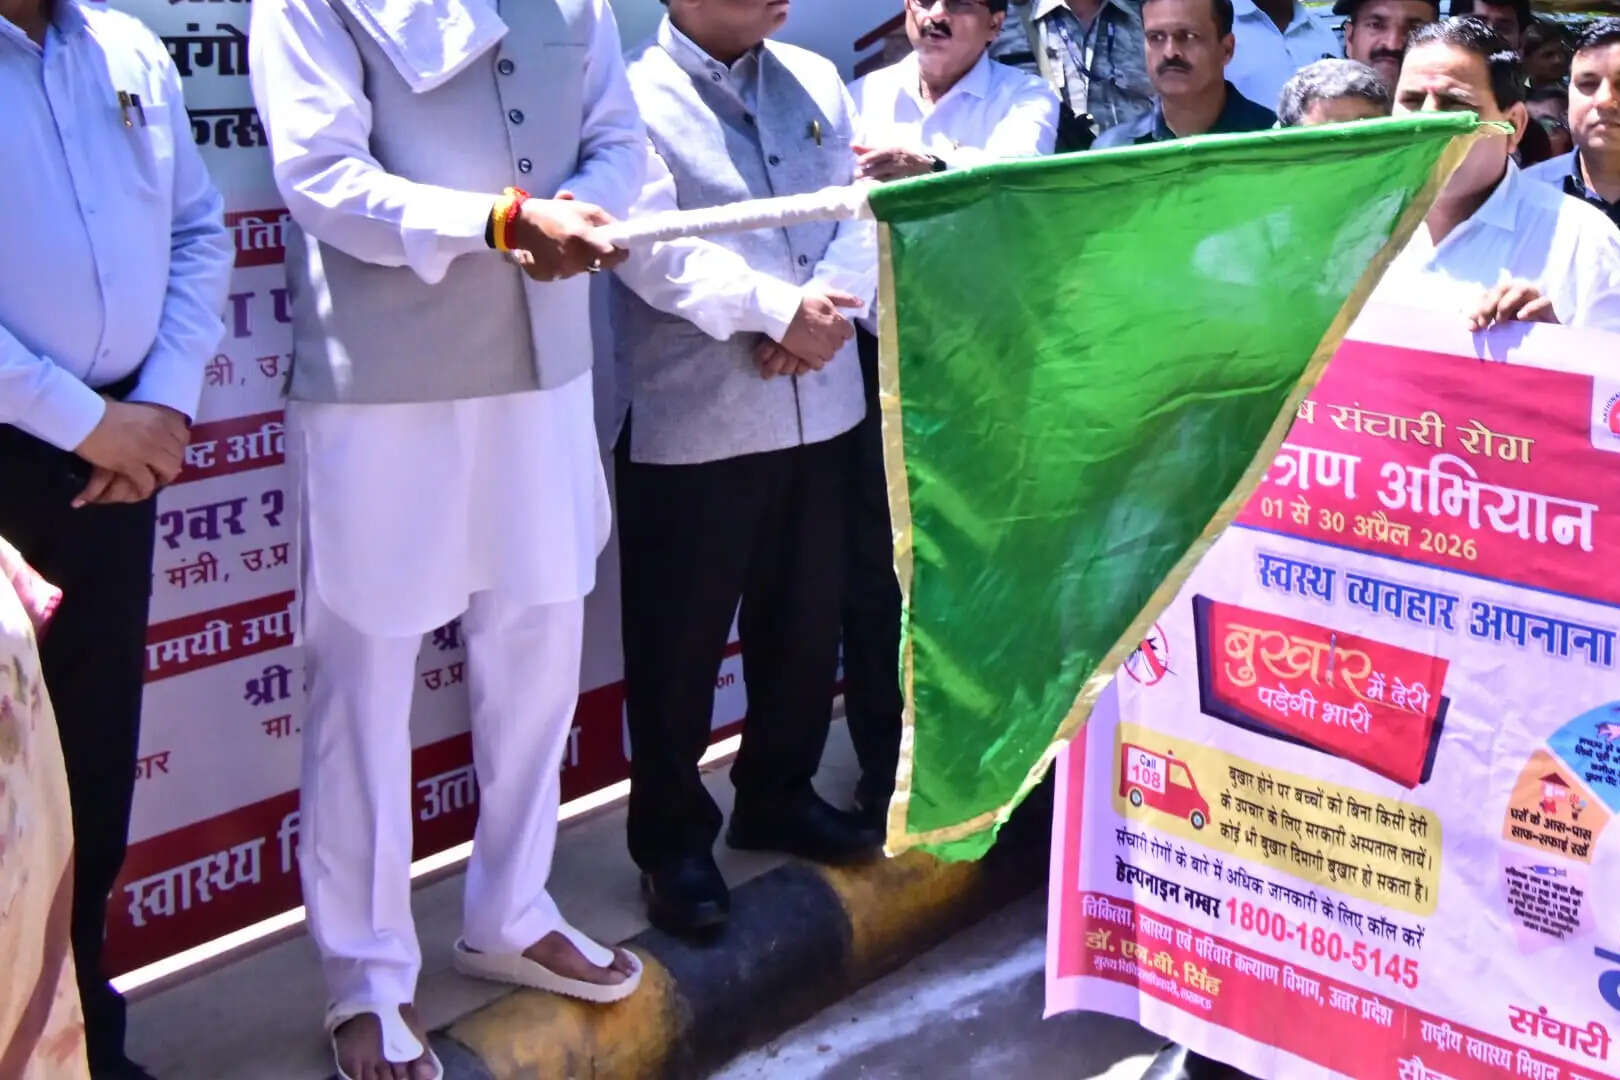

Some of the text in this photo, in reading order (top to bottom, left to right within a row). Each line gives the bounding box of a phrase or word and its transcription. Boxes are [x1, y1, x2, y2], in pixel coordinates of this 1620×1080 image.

[1327, 402, 1446, 448] संचारी
[1456, 420, 1536, 464] रोग
[1261, 493, 1478, 561] 01 से 30 अप्रैल 2026
[1377, 453, 1599, 553] अभियान
[1258, 553, 1336, 602] स्वस्थ
[1346, 573, 1459, 631] व्यवहार
[1470, 600, 1617, 668] अपनाना
[244, 664, 293, 707] श्री
[1321, 701, 1373, 733] भारी
[1368, 669, 1387, 701] में
[1391, 676, 1432, 713] देरी
[1131, 764, 1162, 791] 108
[1139, 753, 1157, 770] Call
[1229, 766, 1254, 791] बुखार
[1256, 773, 1273, 796] होने
[1277, 782, 1291, 800] पर
[1327, 792, 1344, 815] को
[1347, 796, 1372, 818] बिना
[1376, 803, 1405, 832] किसी
[1408, 812, 1428, 839] देरी
[1234, 797, 1265, 819] उपचार
[1281, 809, 1303, 840] लिए
[1305, 820, 1346, 847] सरकारी
[1350, 834, 1398, 861] अस्पताल
[123, 835, 267, 928] स्वास्थ्य
[1115, 825, 1148, 855] संचारी
[1175, 846, 1188, 868] के
[1213, 858, 1225, 880] में
[1226, 867, 1264, 894] अधिक
[1268, 881, 1318, 913] जानकारी
[1321, 896, 1336, 919] के
[1338, 902, 1364, 936] लिए
[1367, 917, 1398, 943] कॉल
[1402, 925, 1426, 950] करें
[1219, 819, 1241, 844] कोई
[1245, 828, 1258, 848] भी
[1261, 835, 1288, 858] बुखार
[1291, 841, 1324, 871] दिमागी
[1327, 858, 1359, 883] बुखार
[1361, 864, 1373, 887] हो
[1376, 871, 1412, 894] सकता
[1226, 896, 1420, 990] 1800-180-5145
[1508, 1004, 1613, 1060] संचारी
